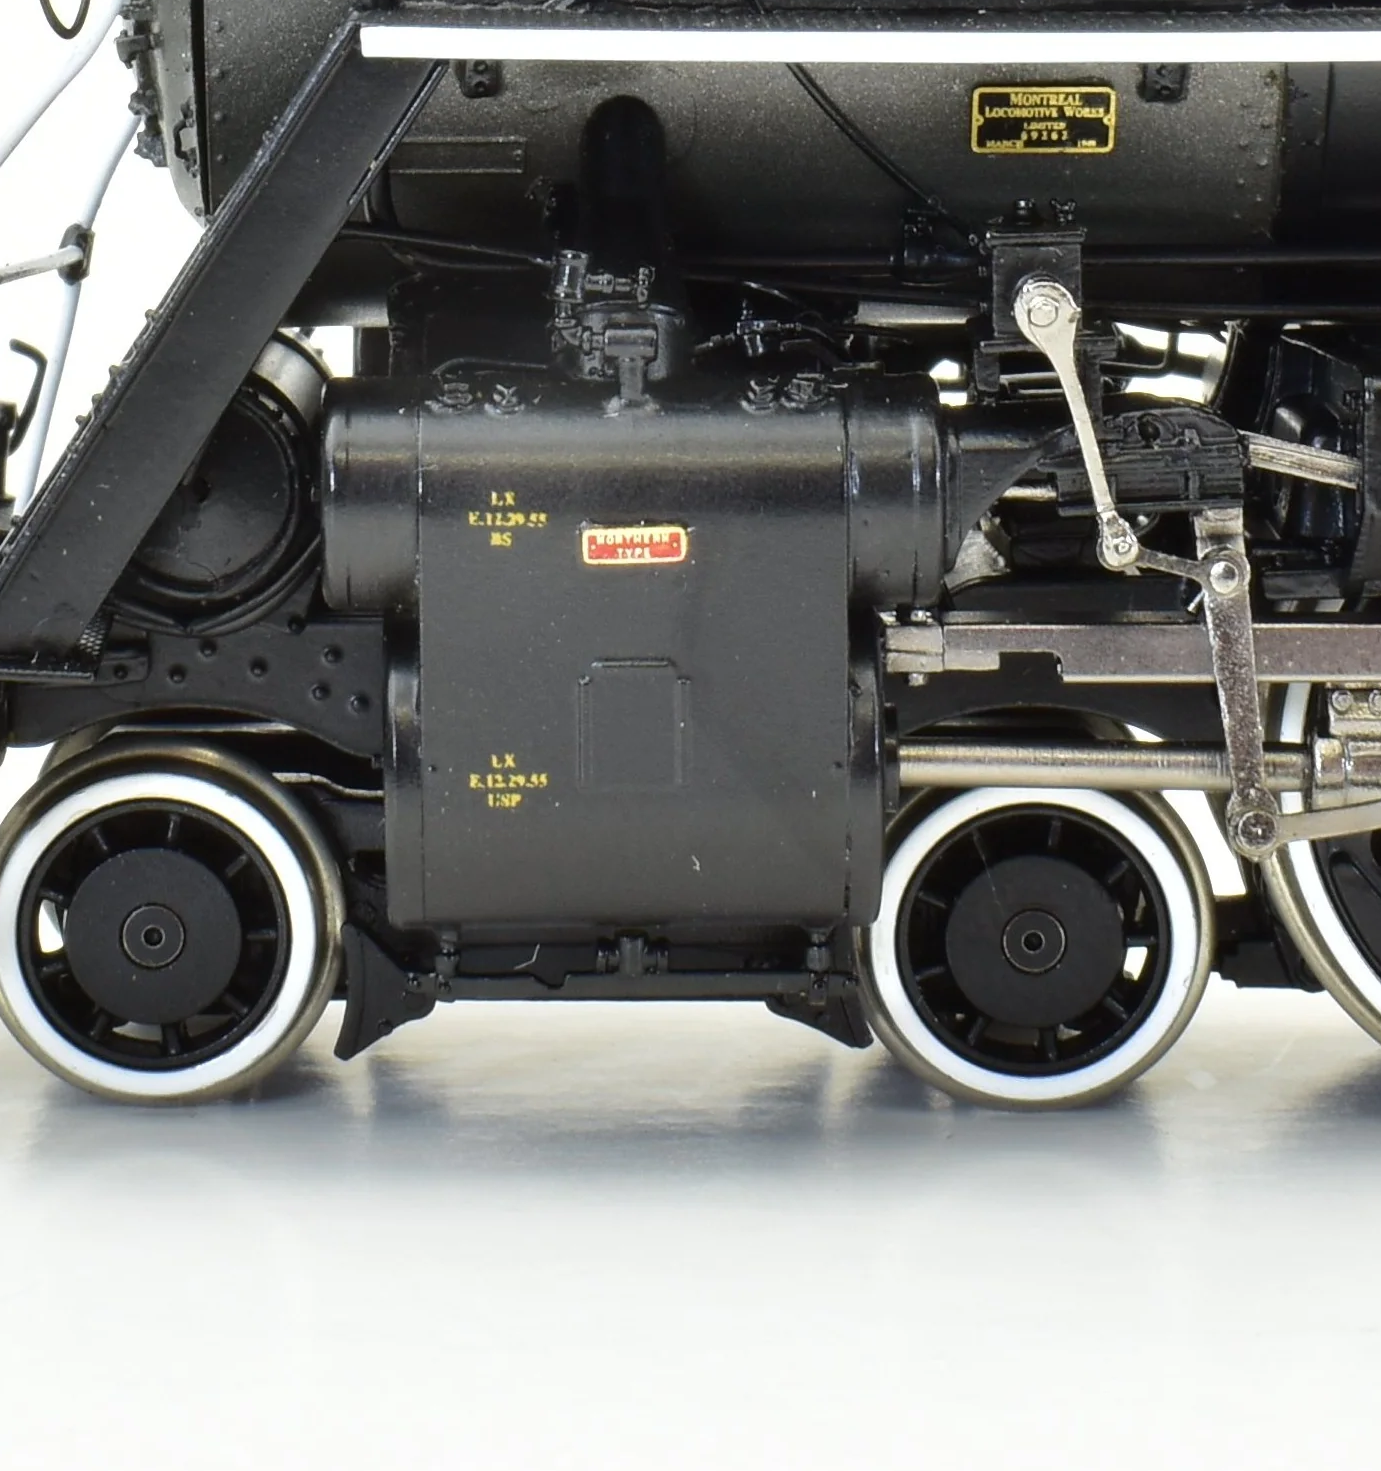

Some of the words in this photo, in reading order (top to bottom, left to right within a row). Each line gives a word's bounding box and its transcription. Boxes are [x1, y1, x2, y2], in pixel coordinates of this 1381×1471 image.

[1009, 92, 1083, 106] MONTREAL
[985, 106, 1058, 118] LOCOMOTIVE
[1063, 106, 1105, 118] WORKS
[616, 546, 652, 559] TYPE
[490, 753, 516, 769] LX
